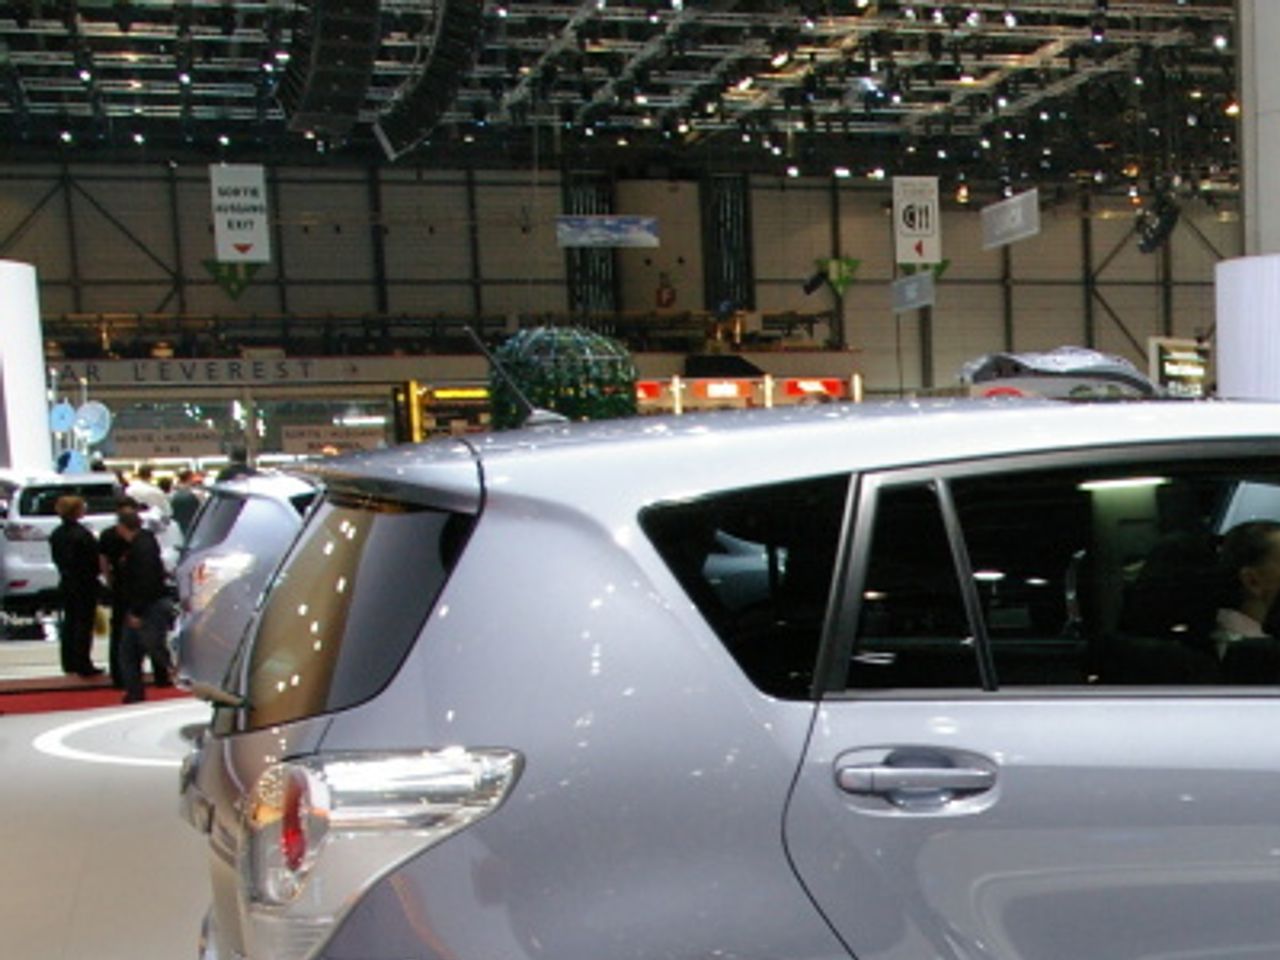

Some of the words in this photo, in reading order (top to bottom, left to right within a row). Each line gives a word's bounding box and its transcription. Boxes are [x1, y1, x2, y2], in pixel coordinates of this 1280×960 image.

[217, 186, 260, 198] SORTIE
[227, 219, 255, 231] EXIT
[132, 361, 314, 382] L'EVEREST
